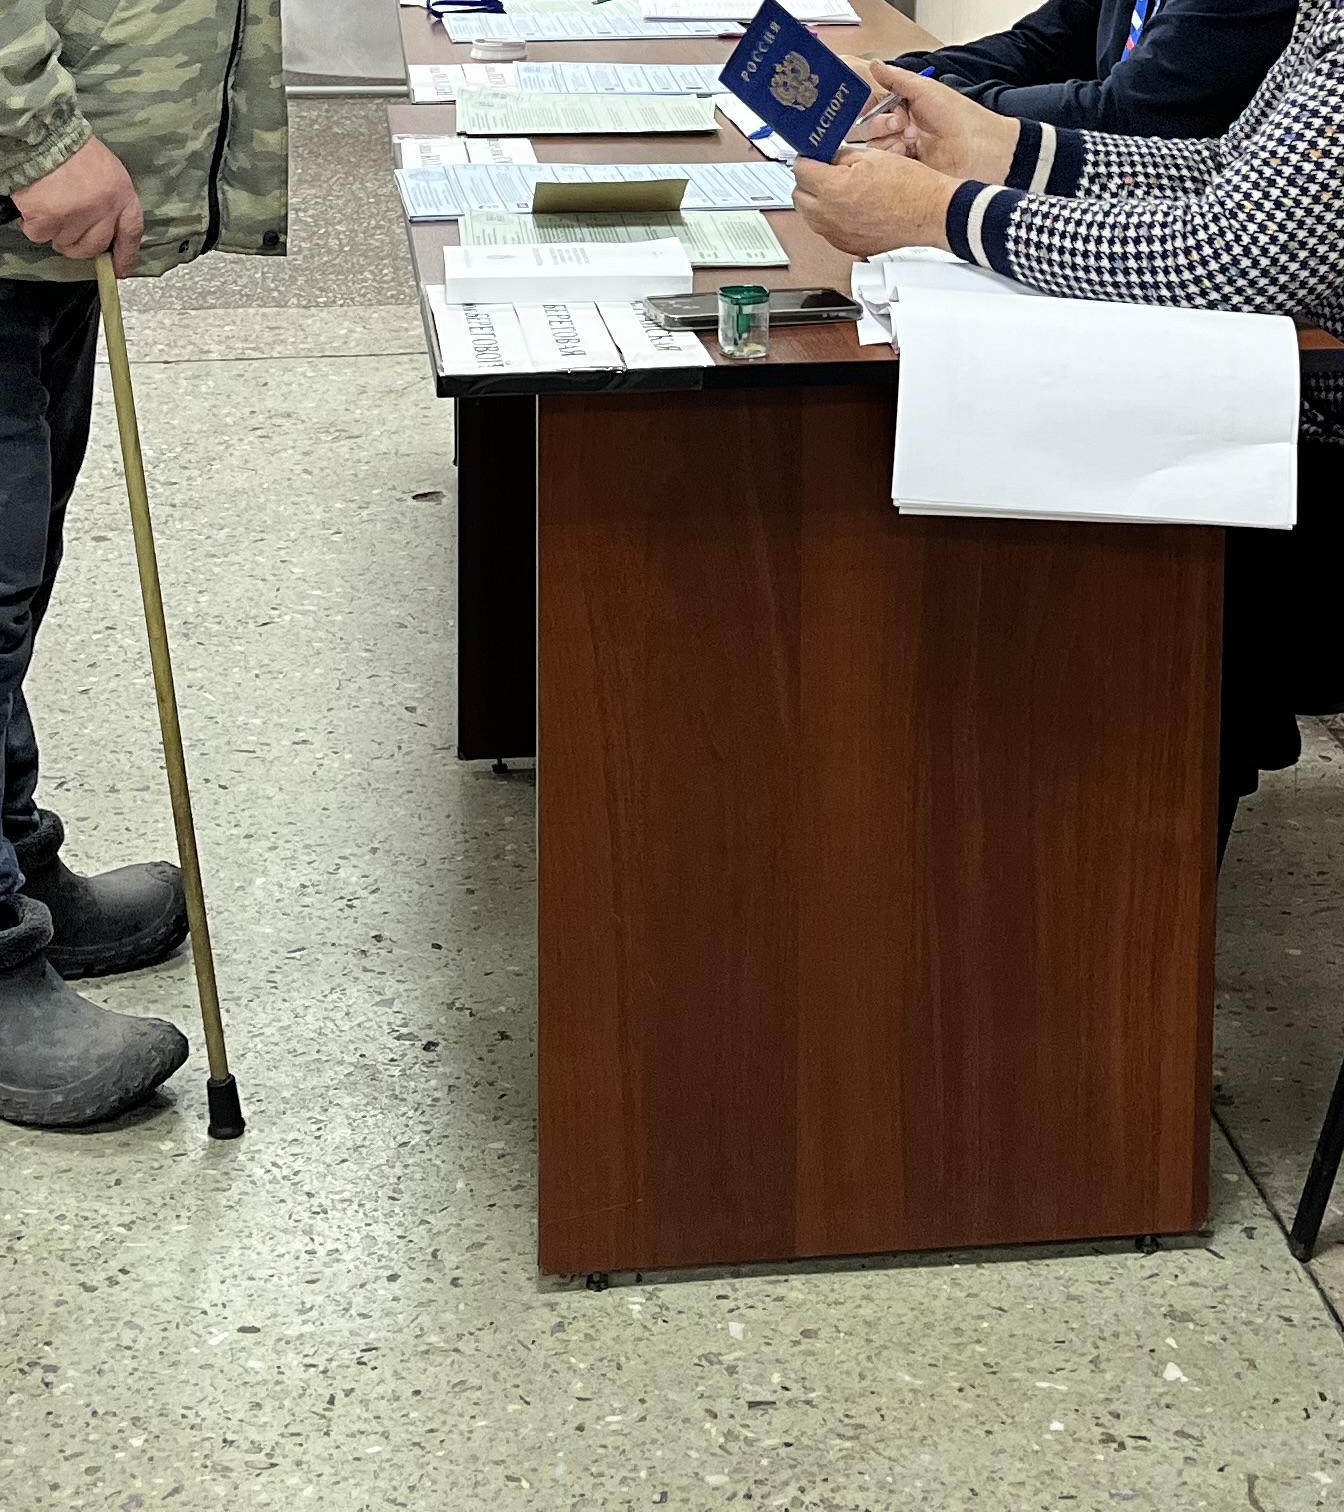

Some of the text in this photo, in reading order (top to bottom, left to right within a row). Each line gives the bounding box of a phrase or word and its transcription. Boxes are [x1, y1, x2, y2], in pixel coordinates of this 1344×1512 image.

[740, 21, 782, 83] РОССИЯ
[807, 82, 850, 148] ПАСПОРТ
[465, 312, 512, 368] БЕРЕГОВОЙ
[541, 303, 587, 357] БЕРЕГОВАЯ
